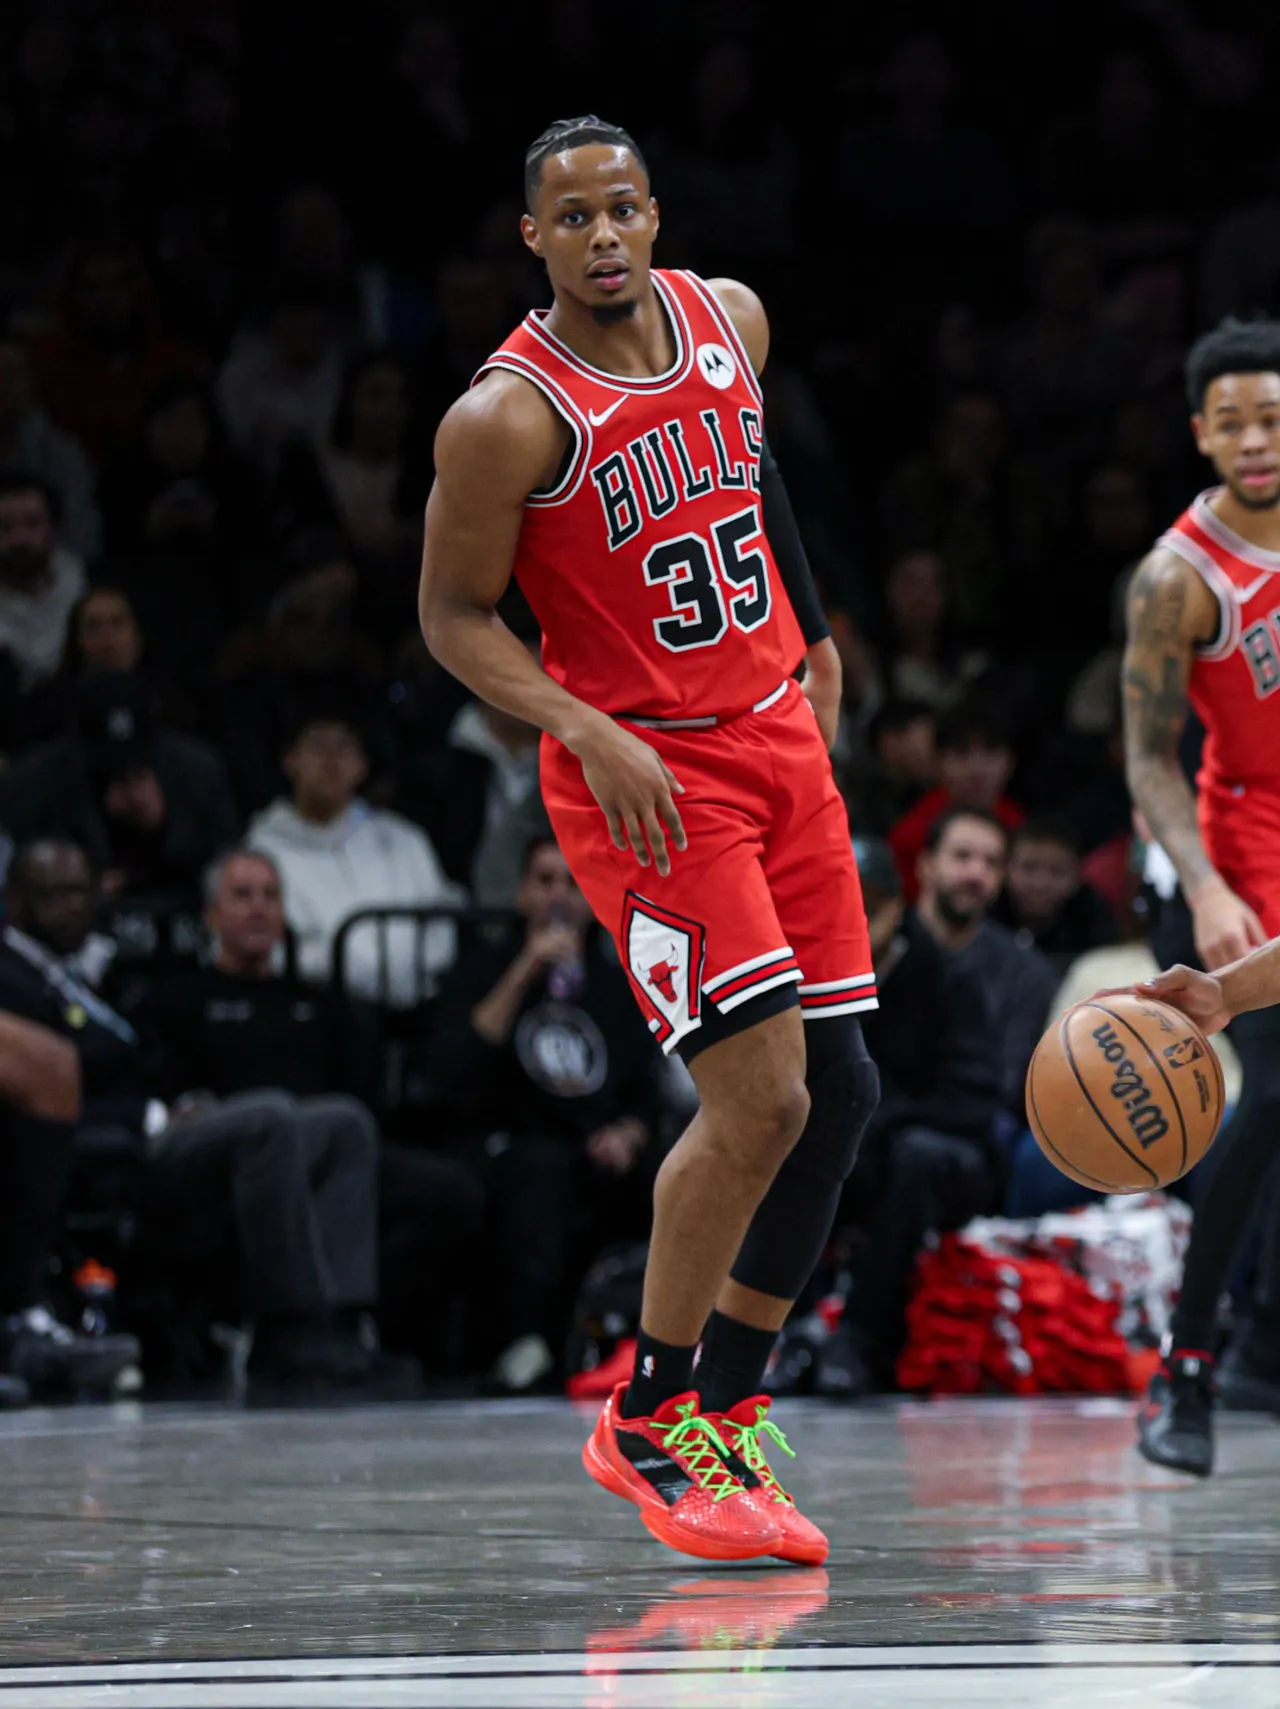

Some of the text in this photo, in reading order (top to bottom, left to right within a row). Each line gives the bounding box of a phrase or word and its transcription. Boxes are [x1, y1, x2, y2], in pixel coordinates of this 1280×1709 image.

[590, 407, 762, 552] BULLS
[641, 505, 771, 652] 35
[1092, 1022, 1169, 1149] Wilson
